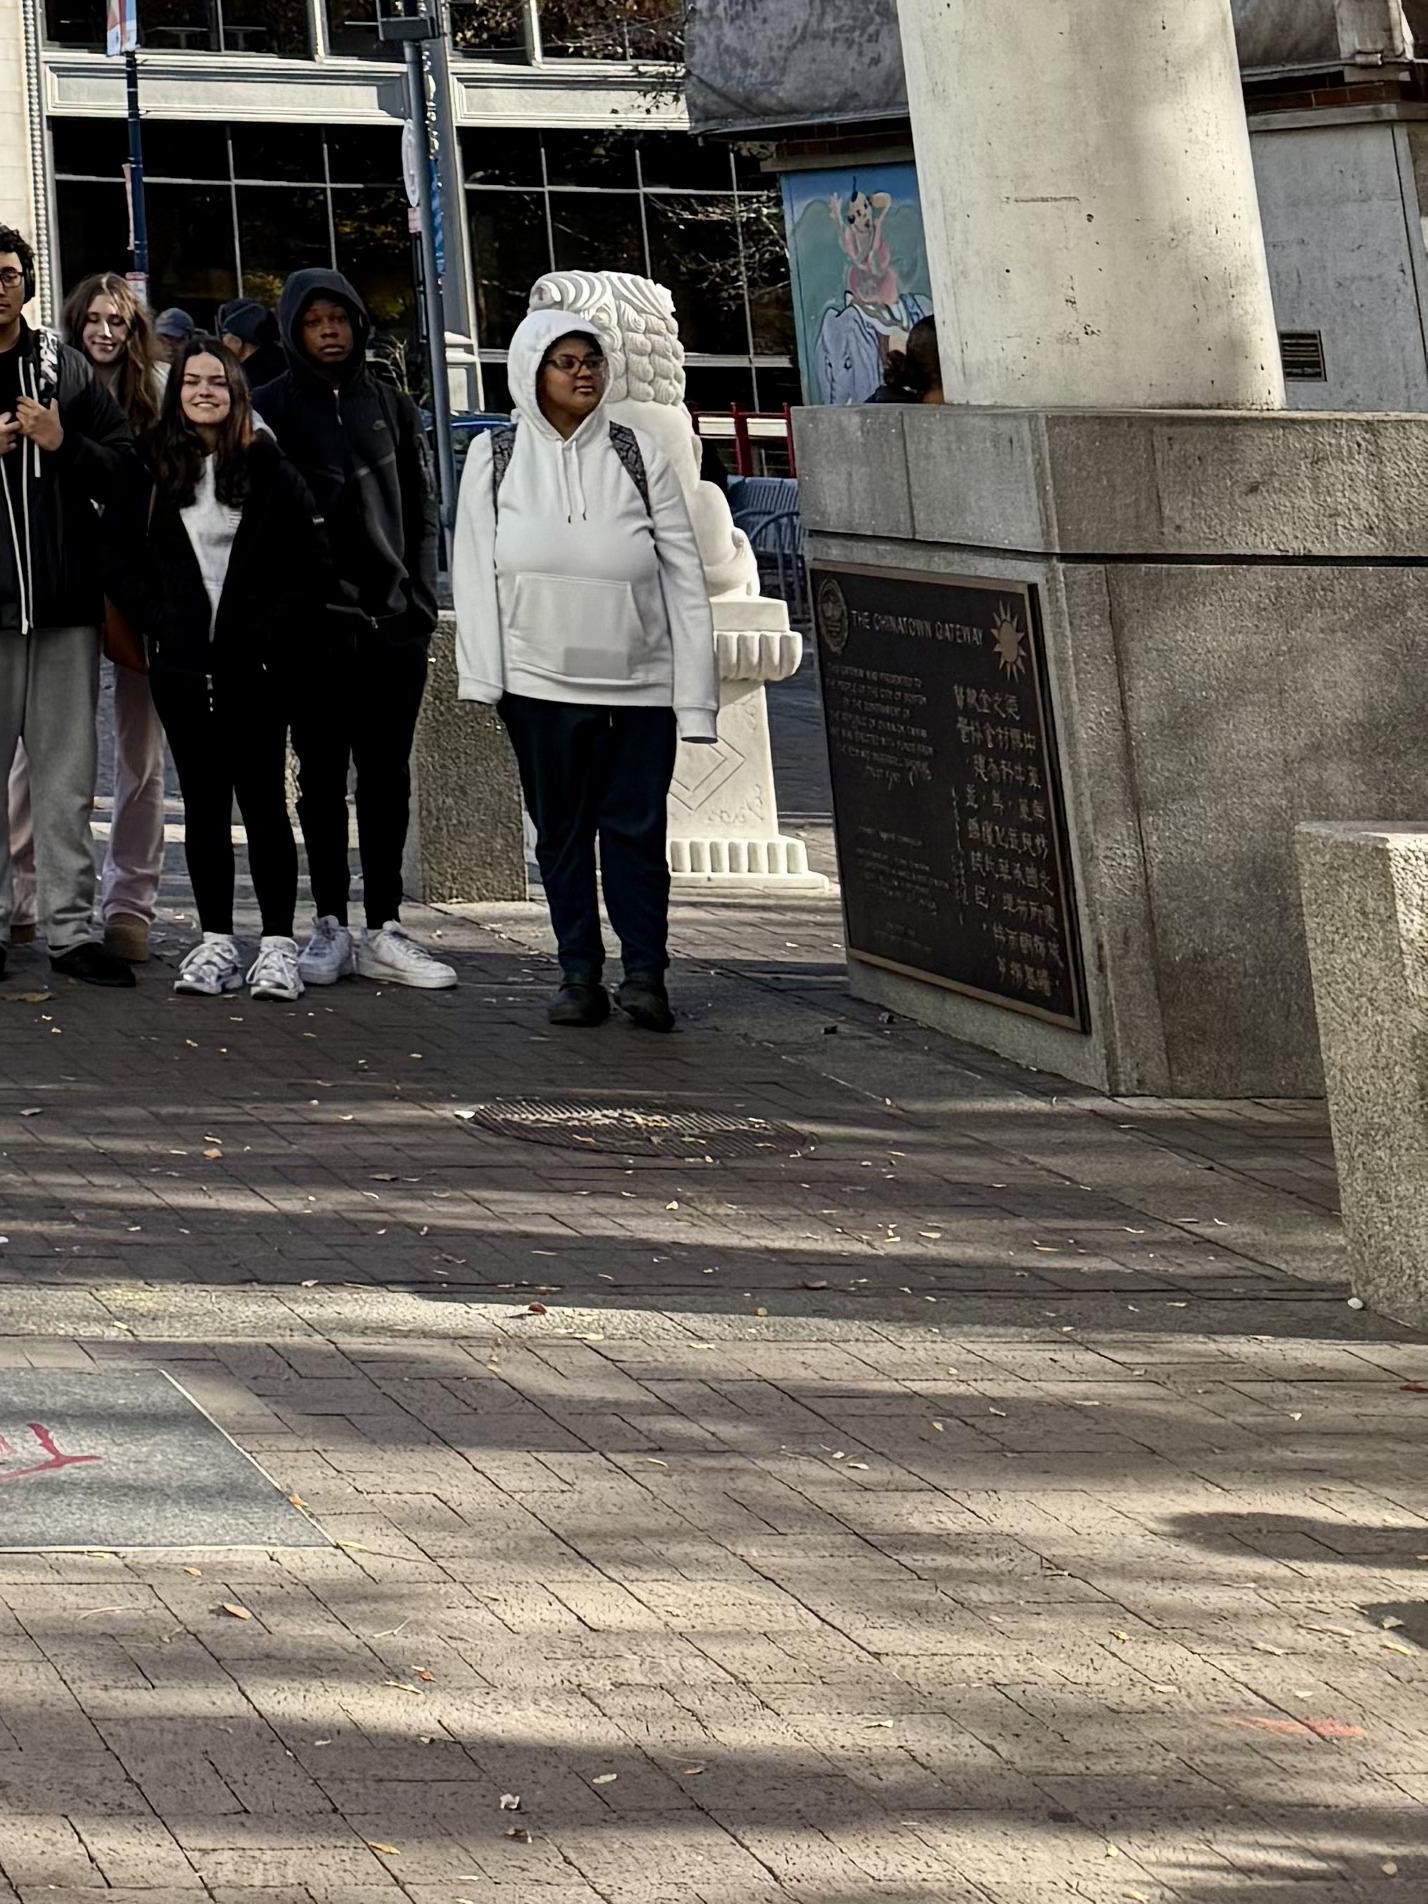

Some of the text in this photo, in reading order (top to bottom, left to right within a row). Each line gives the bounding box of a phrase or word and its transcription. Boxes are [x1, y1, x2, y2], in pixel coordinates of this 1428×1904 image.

[850, 609, 984, 646] THE CHINATOWN GATEWAY
